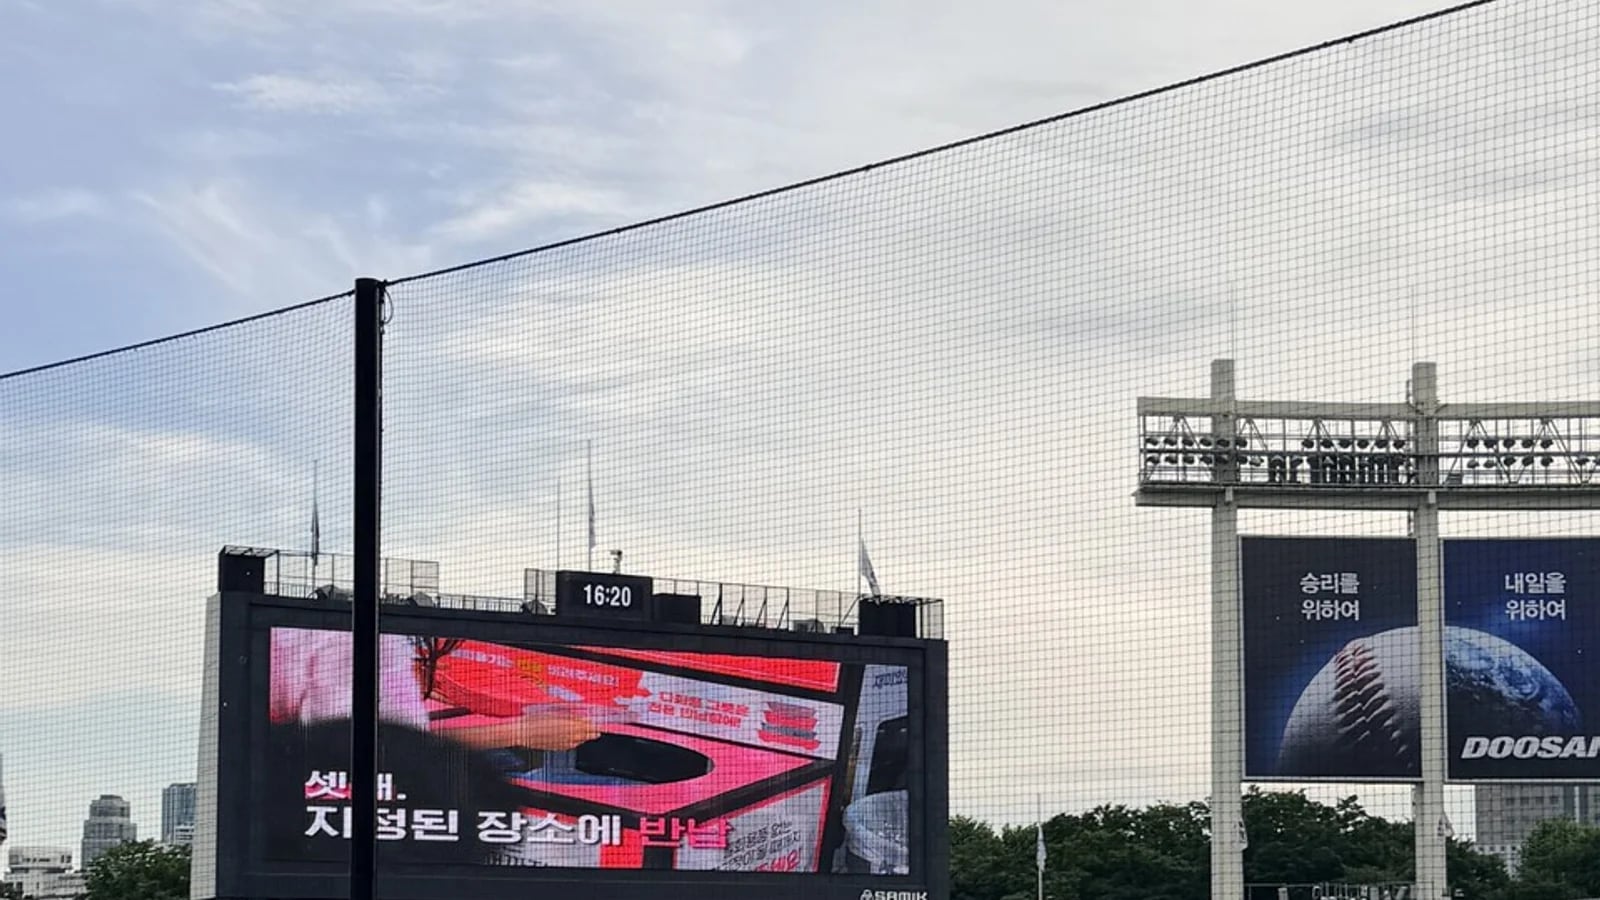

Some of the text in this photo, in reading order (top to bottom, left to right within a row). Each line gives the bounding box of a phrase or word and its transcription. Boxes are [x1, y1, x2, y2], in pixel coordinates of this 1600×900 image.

[1299, 572, 1360, 594] 승리를
[1504, 572, 1567, 594] 내일을
[583, 584, 632, 607] 16:20
[1301, 599, 1360, 621] 위하여
[1505, 599, 1566, 621] 위하여
[477, 811, 623, 846] 장소에
[639, 817, 732, 848] 반납
